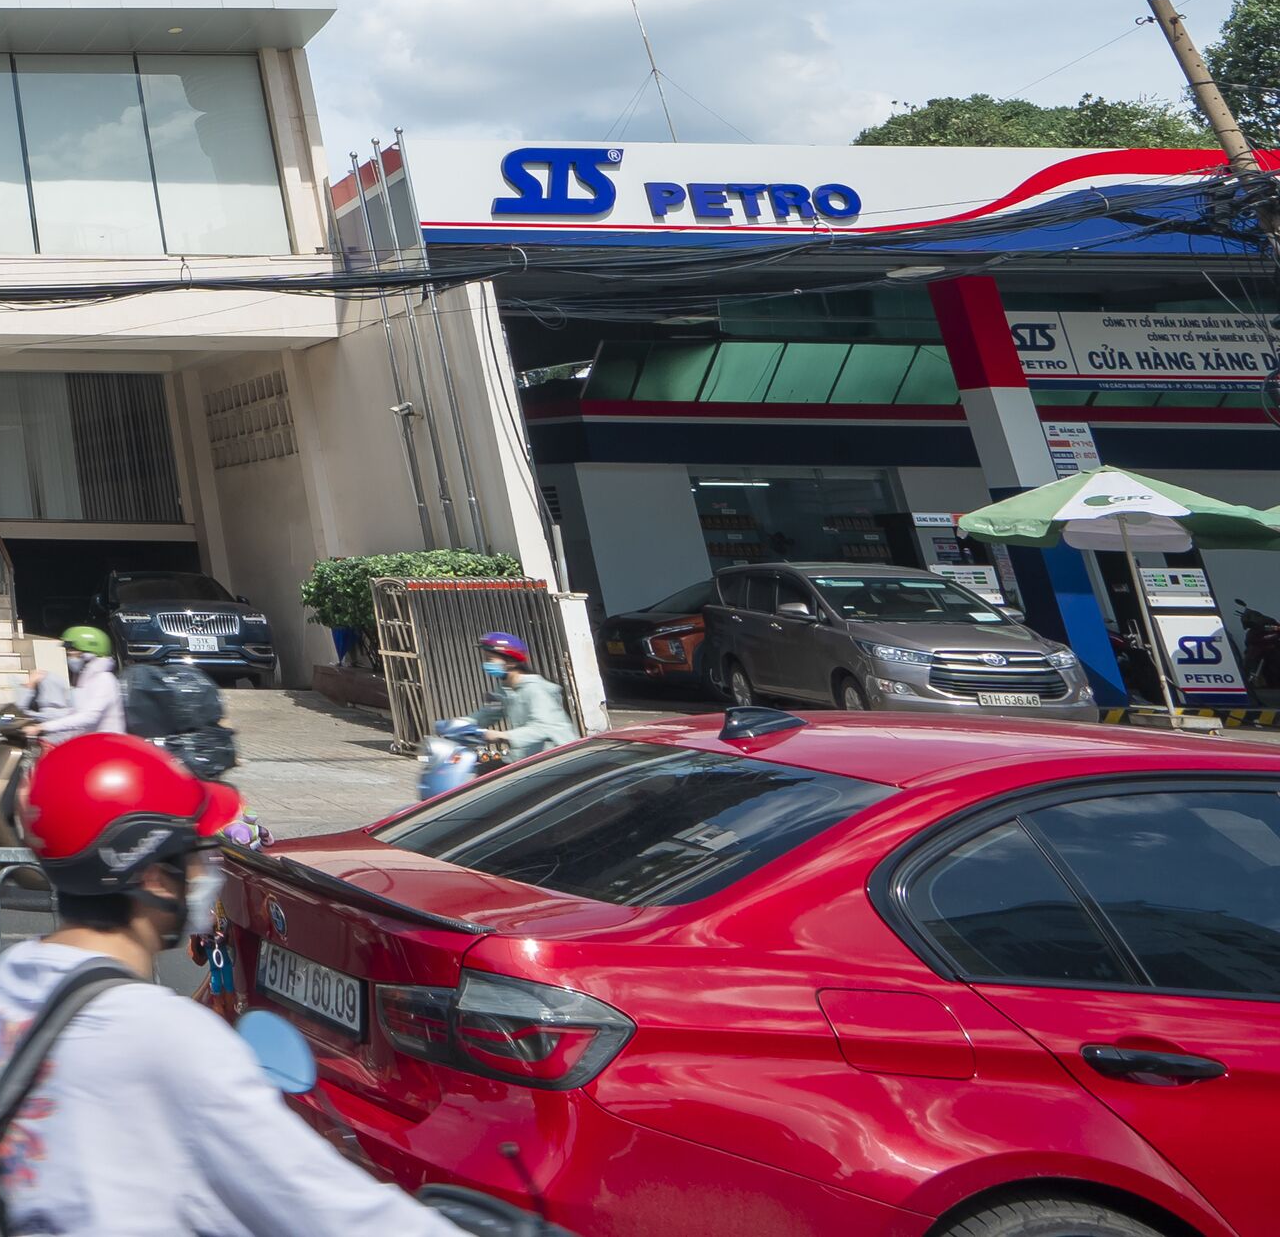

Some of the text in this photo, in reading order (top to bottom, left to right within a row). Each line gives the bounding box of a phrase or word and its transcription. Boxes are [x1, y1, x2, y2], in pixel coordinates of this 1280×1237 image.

[491, 148, 862, 219] STS PETRO
[1103, 317, 1126, 328] CÔNG
[1127, 319, 1138, 328] TY
[1010, 323, 1057, 352] STS
[1171, 334, 1182, 342] TY
[1088, 343, 1133, 371] CỬA
[1136, 346, 1197, 371] HÀNG
[1199, 347, 1259, 371] XĂNG
[1177, 635, 1222, 665] STS
[1184, 673, 1235, 684] PETRO
